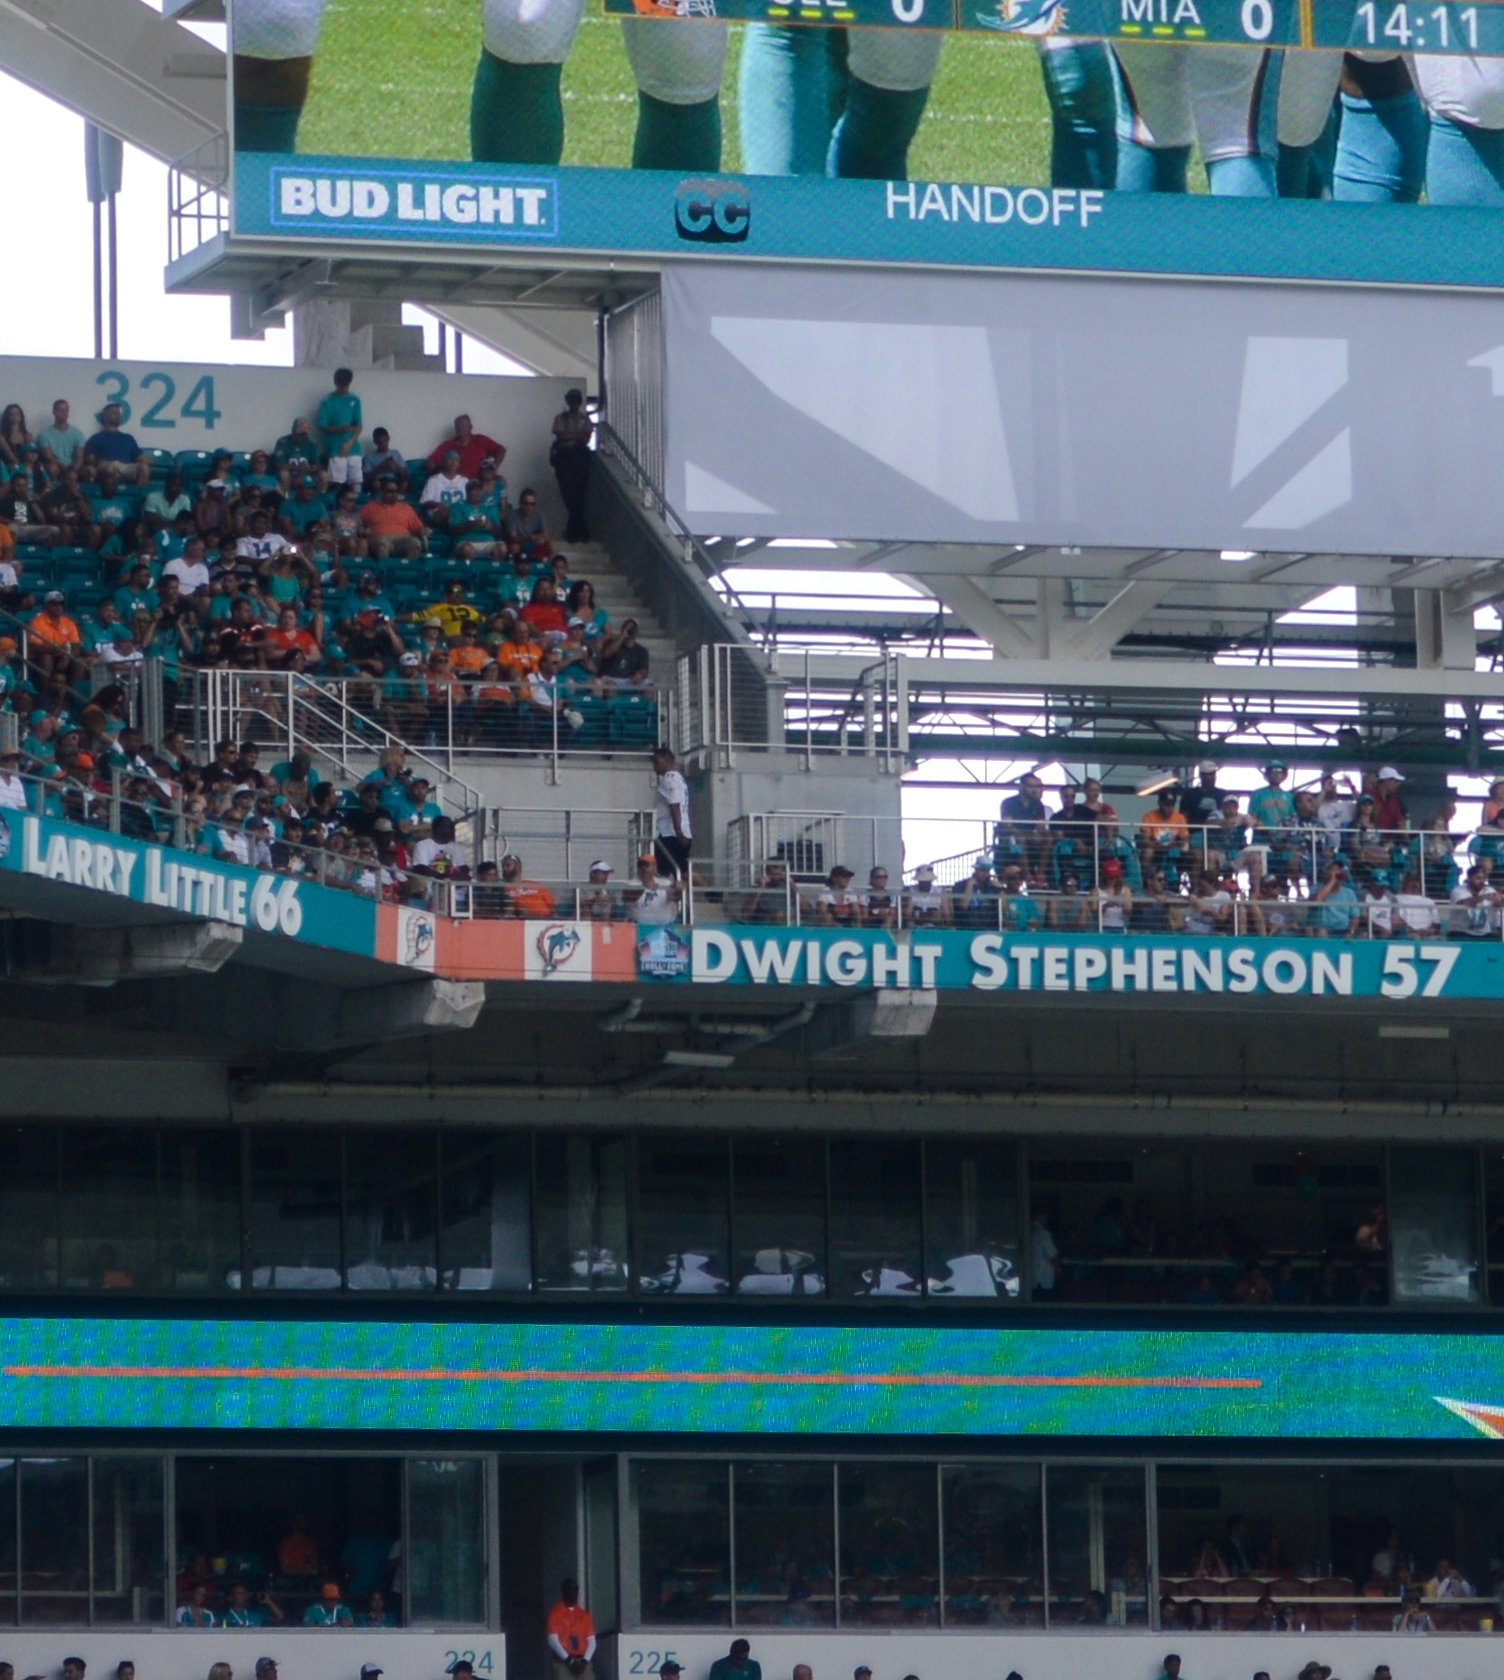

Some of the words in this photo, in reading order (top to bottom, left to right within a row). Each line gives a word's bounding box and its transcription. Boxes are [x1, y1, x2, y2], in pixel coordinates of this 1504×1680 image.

[1356, 2, 1480, 49] 14:11
[280, 177, 389, 218] BUD
[396, 182, 547, 225] LIGHT
[675, 187, 750, 234] CC
[885, 181, 1103, 228] HANDOFF
[95, 370, 222, 431] 324
[22, 815, 137, 898] LARRY
[143, 846, 248, 927] LITTLE
[249, 874, 303, 938] 66
[692, 928, 942, 988] DWIGHT
[969, 933, 1354, 996] STEPHENSON
[1380, 944, 1462, 999] 57
